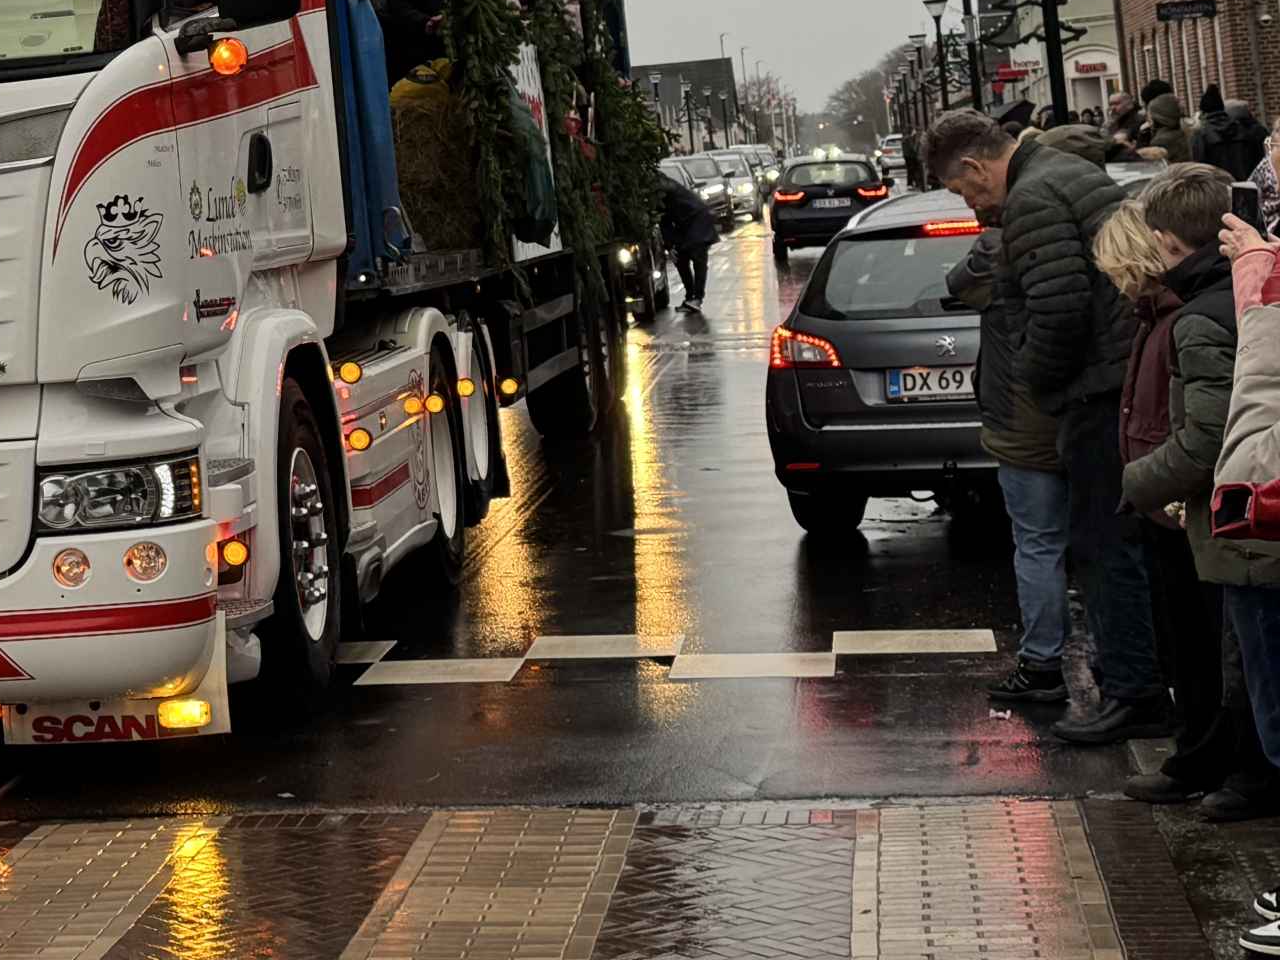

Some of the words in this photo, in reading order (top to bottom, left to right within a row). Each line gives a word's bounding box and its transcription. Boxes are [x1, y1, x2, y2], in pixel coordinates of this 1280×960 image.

[903, 372, 932, 392] DX
[938, 369, 965, 390] 69
[32, 714, 200, 743] SCAN
